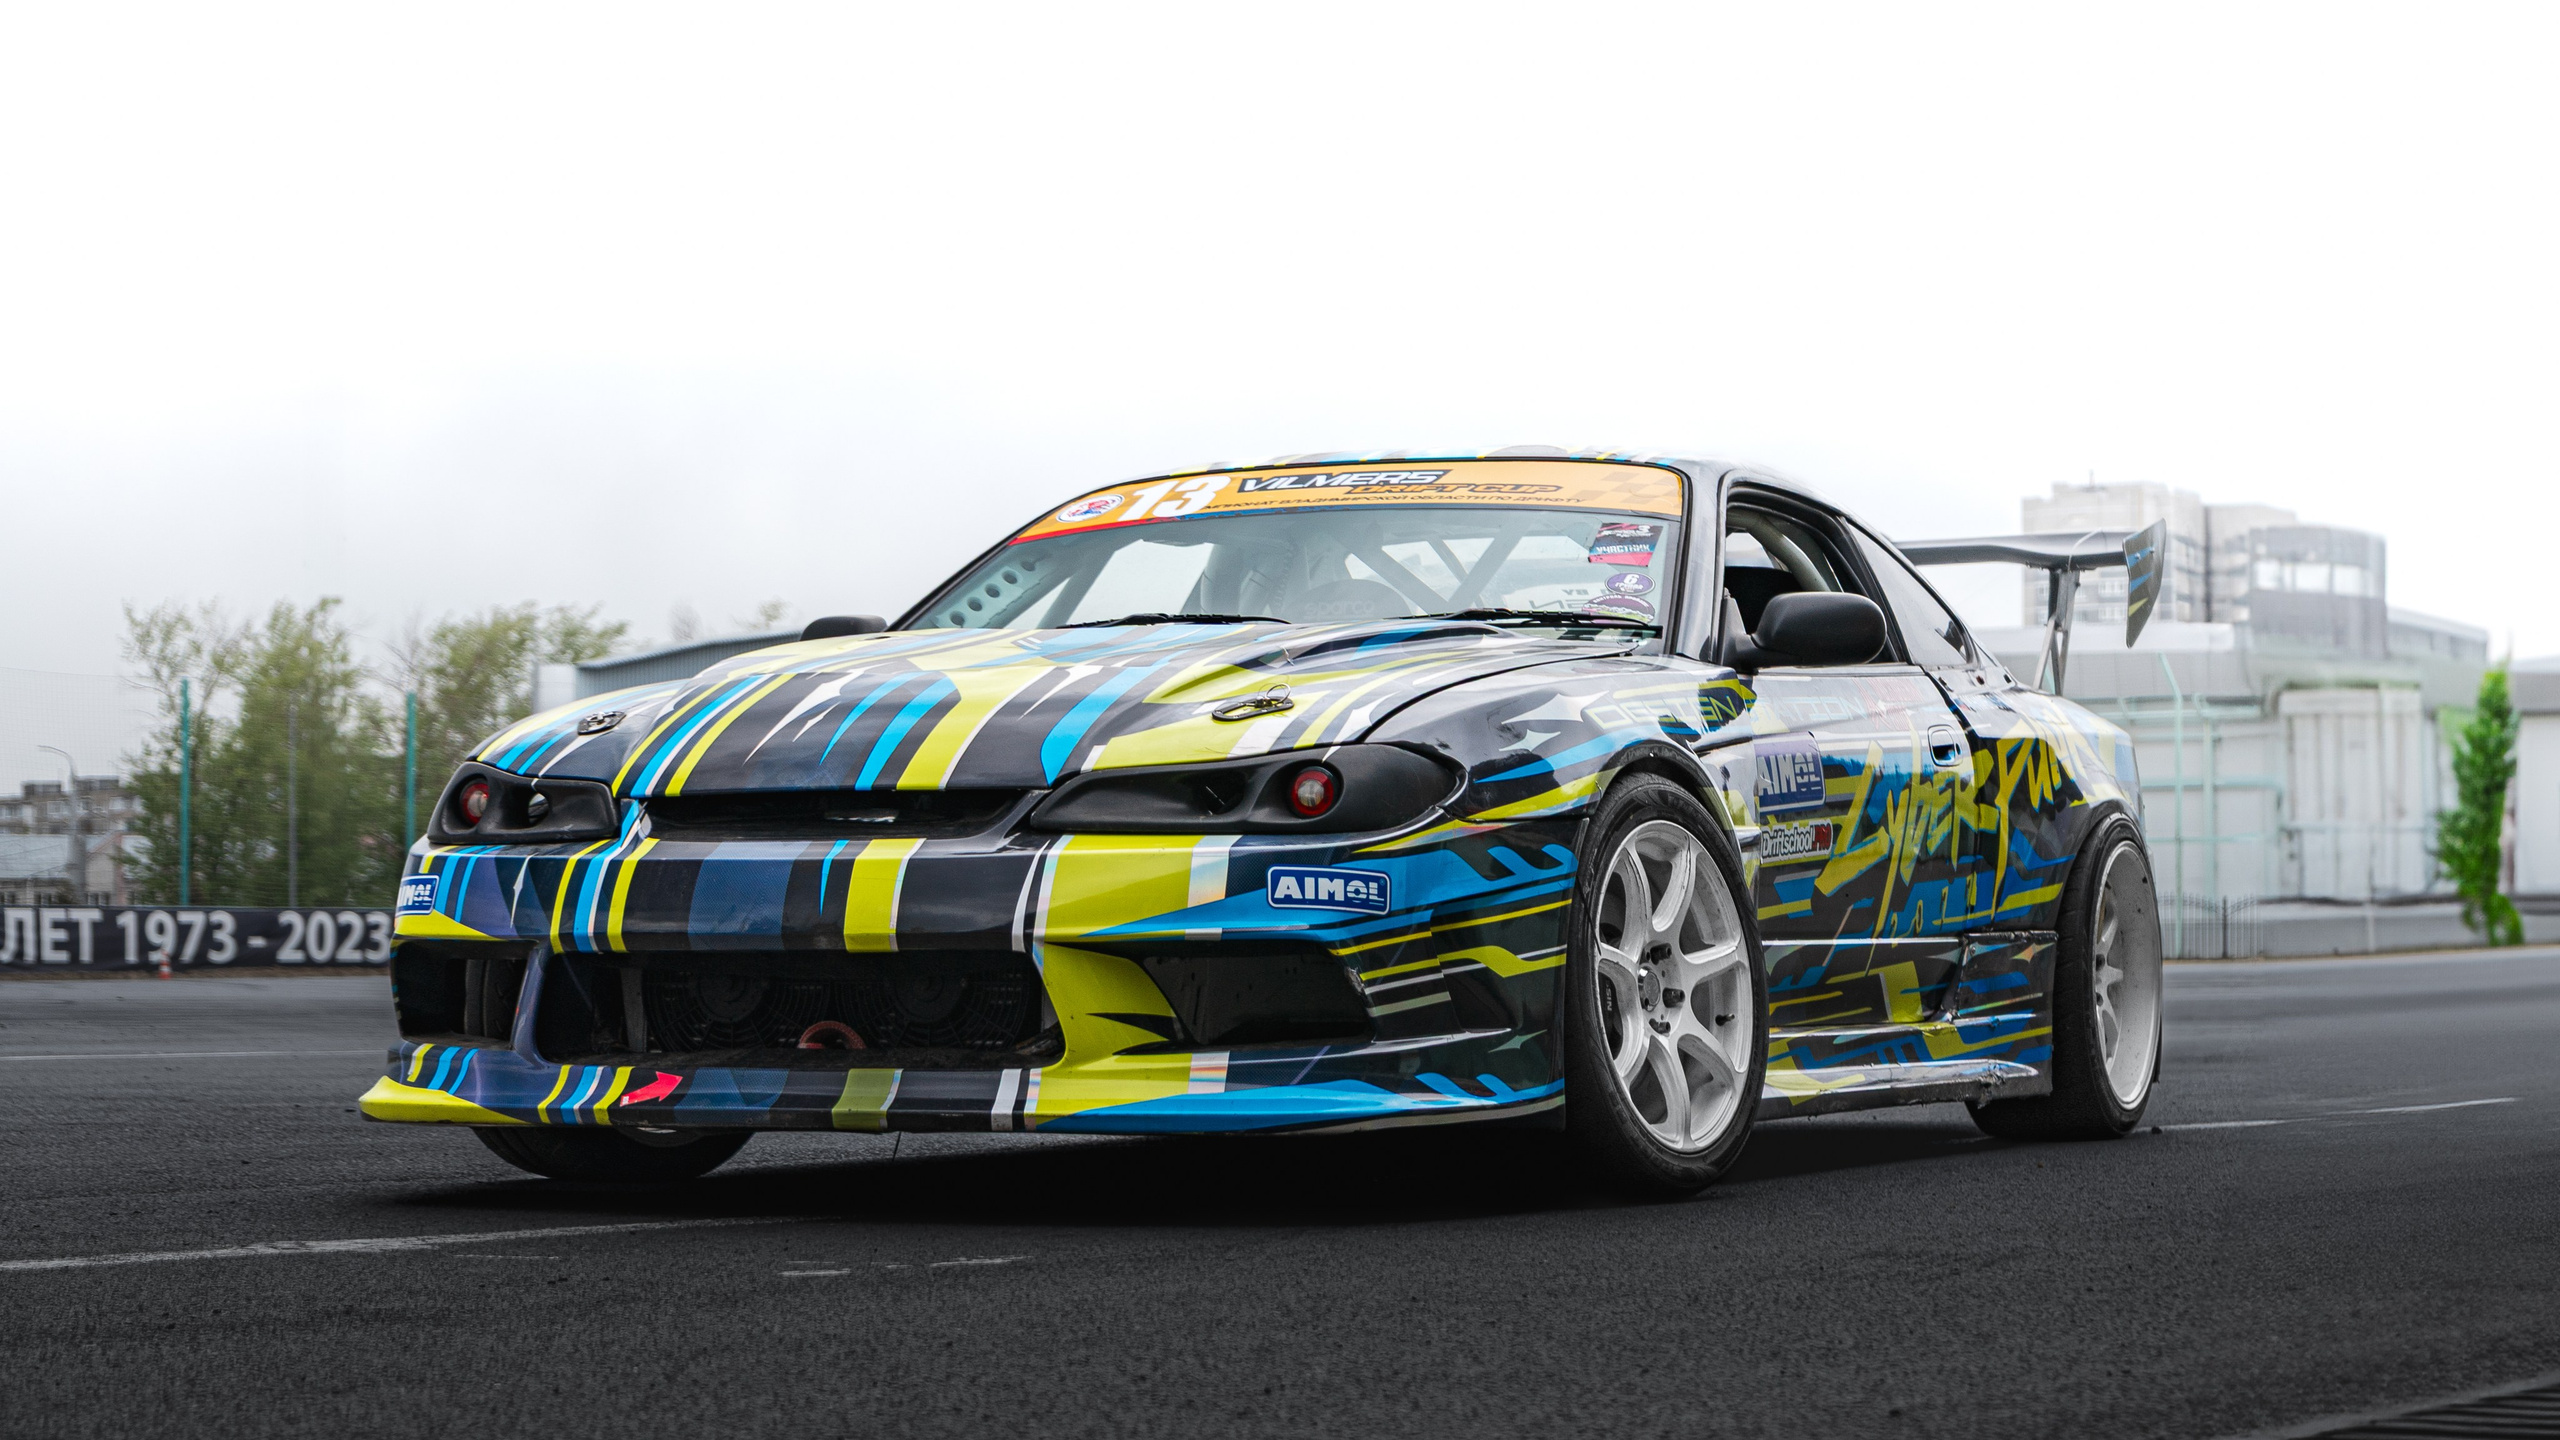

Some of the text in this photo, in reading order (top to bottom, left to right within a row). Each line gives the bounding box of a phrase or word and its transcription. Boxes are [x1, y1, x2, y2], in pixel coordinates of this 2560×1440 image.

[1243, 470, 1446, 492] VILMERS
[1350, 483, 1562, 494] DRIFT CUP
[1117, 475, 1231, 521] 13
[1624, 573, 1640, 585] 6
[1585, 695, 1738, 730] DESIGN
[1757, 752, 1821, 796] AIMOL
[397, 884, 433, 906] IMOL
[1274, 876, 1385, 903] AIMOL
[0, 907, 104, 965] ЛЕТ
[116, 909, 238, 965] 1973
[276, 909, 391, 964] 2023
